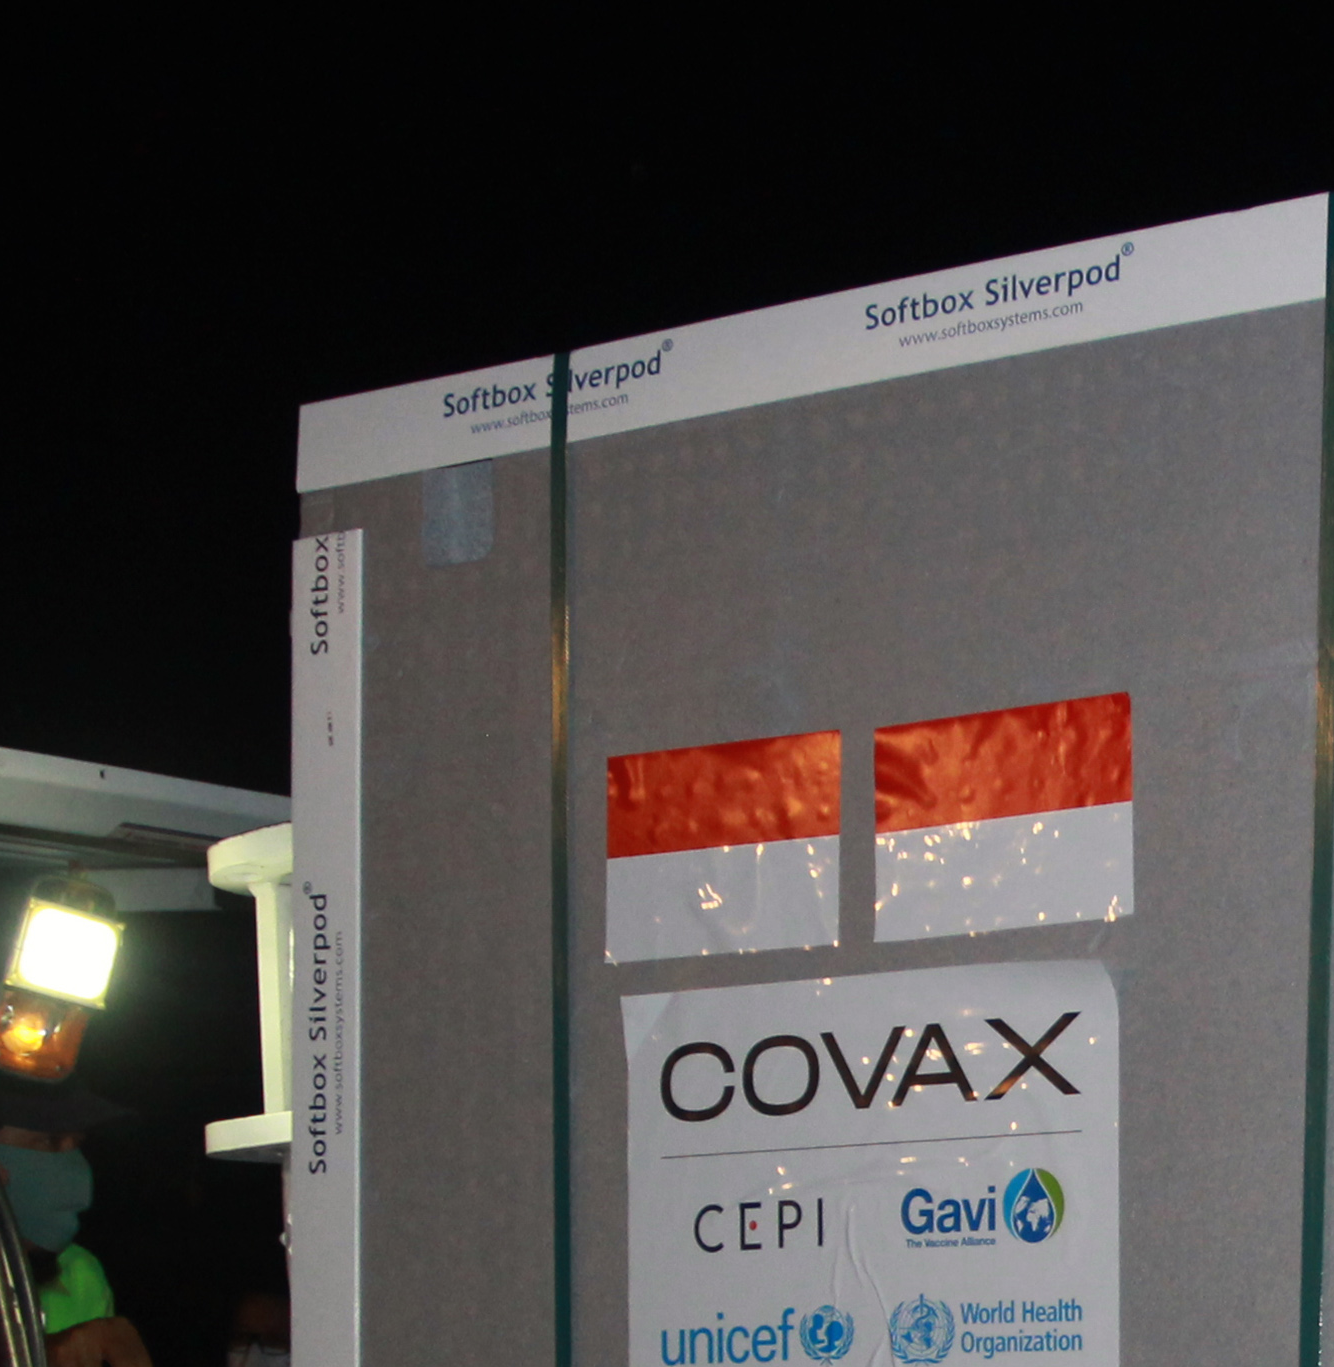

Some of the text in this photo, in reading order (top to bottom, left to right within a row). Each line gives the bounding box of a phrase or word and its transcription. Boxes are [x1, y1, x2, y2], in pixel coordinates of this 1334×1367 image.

[865, 290, 974, 330] Softbox
[898, 301, 1084, 347] www.softboxsystems.com
[443, 381, 536, 417] Softbox
[310, 535, 329, 656] Softbox
[335, 931, 343, 1135] www.softboxsystems.com
[660, 1011, 1083, 1123] COVAX
[309, 1053, 328, 1174] Softbox
[693, 1198, 824, 1253] CEPI
[901, 1185, 996, 1235] Gavi
[906, 1237, 996, 1248] The Vaccine Alliance
[960, 1298, 1083, 1324] World Health
[661, 1308, 795, 1367] unicef
[960, 1329, 1083, 1360] Organization
